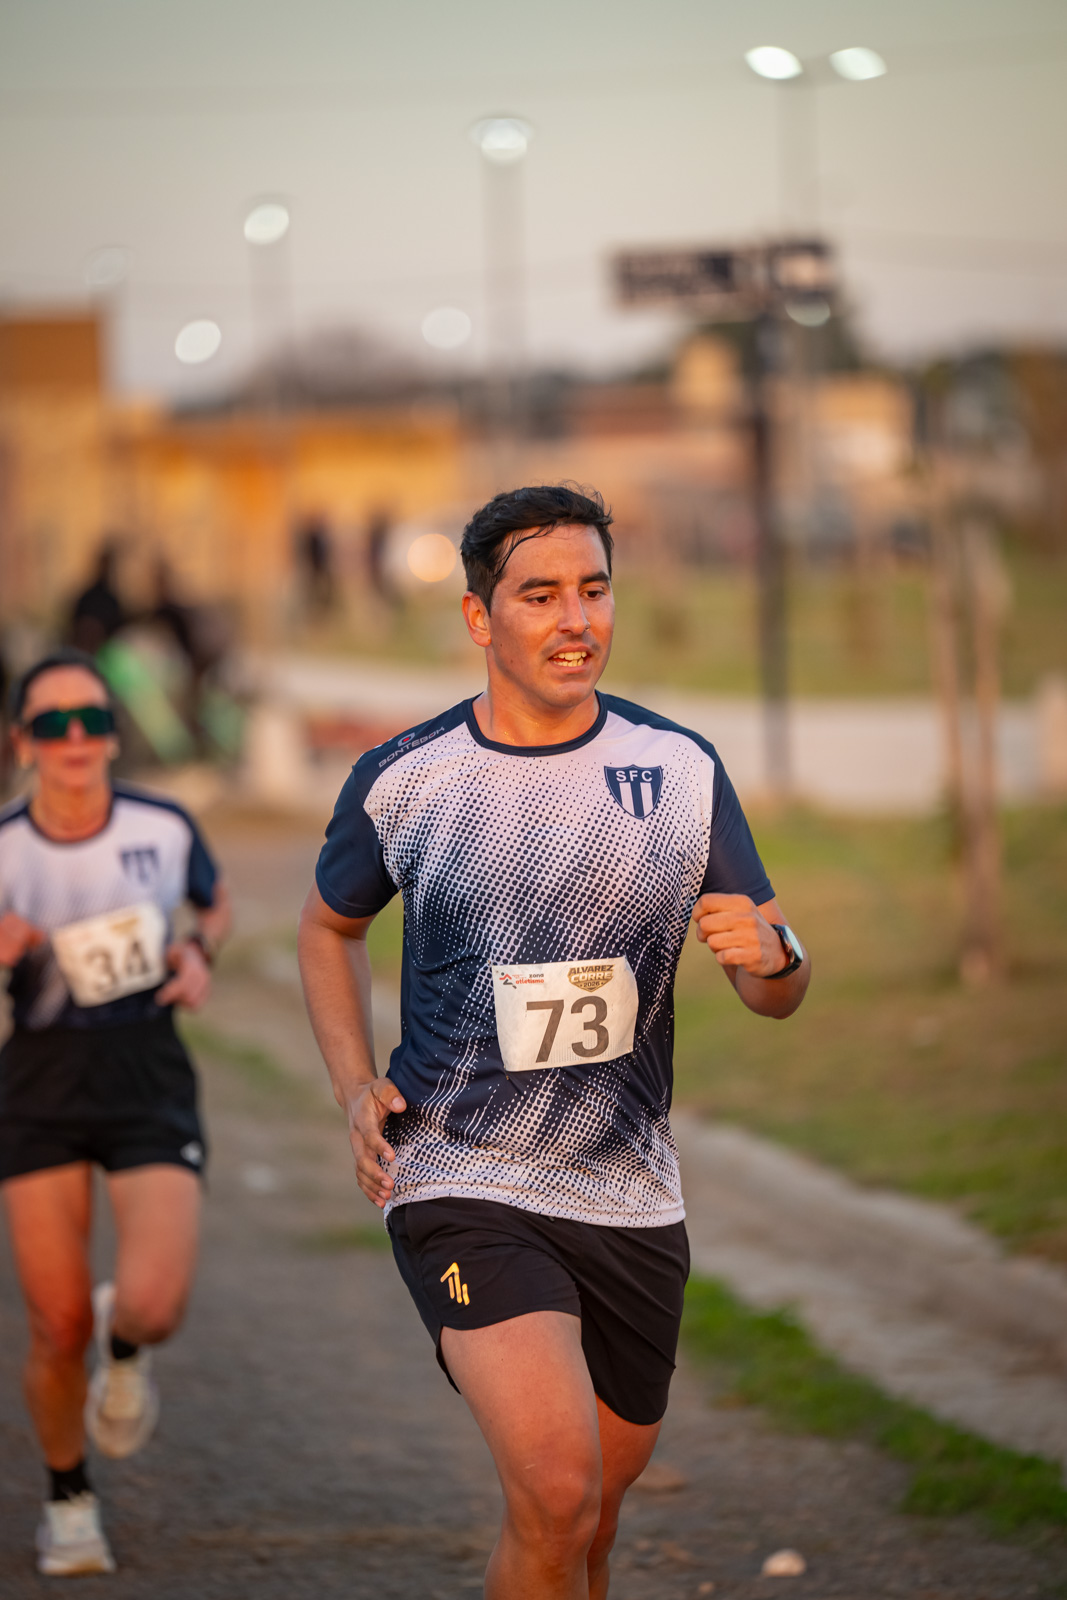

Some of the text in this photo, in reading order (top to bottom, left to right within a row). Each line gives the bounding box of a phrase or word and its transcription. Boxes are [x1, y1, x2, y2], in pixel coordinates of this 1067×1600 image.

[378, 726, 445, 768] BONTEBOK
[615, 770, 653, 782] SFC
[568, 964, 615, 976] ALVAREZ
[570, 971, 612, 983] CORRE
[526, 995, 610, 1064] 73
